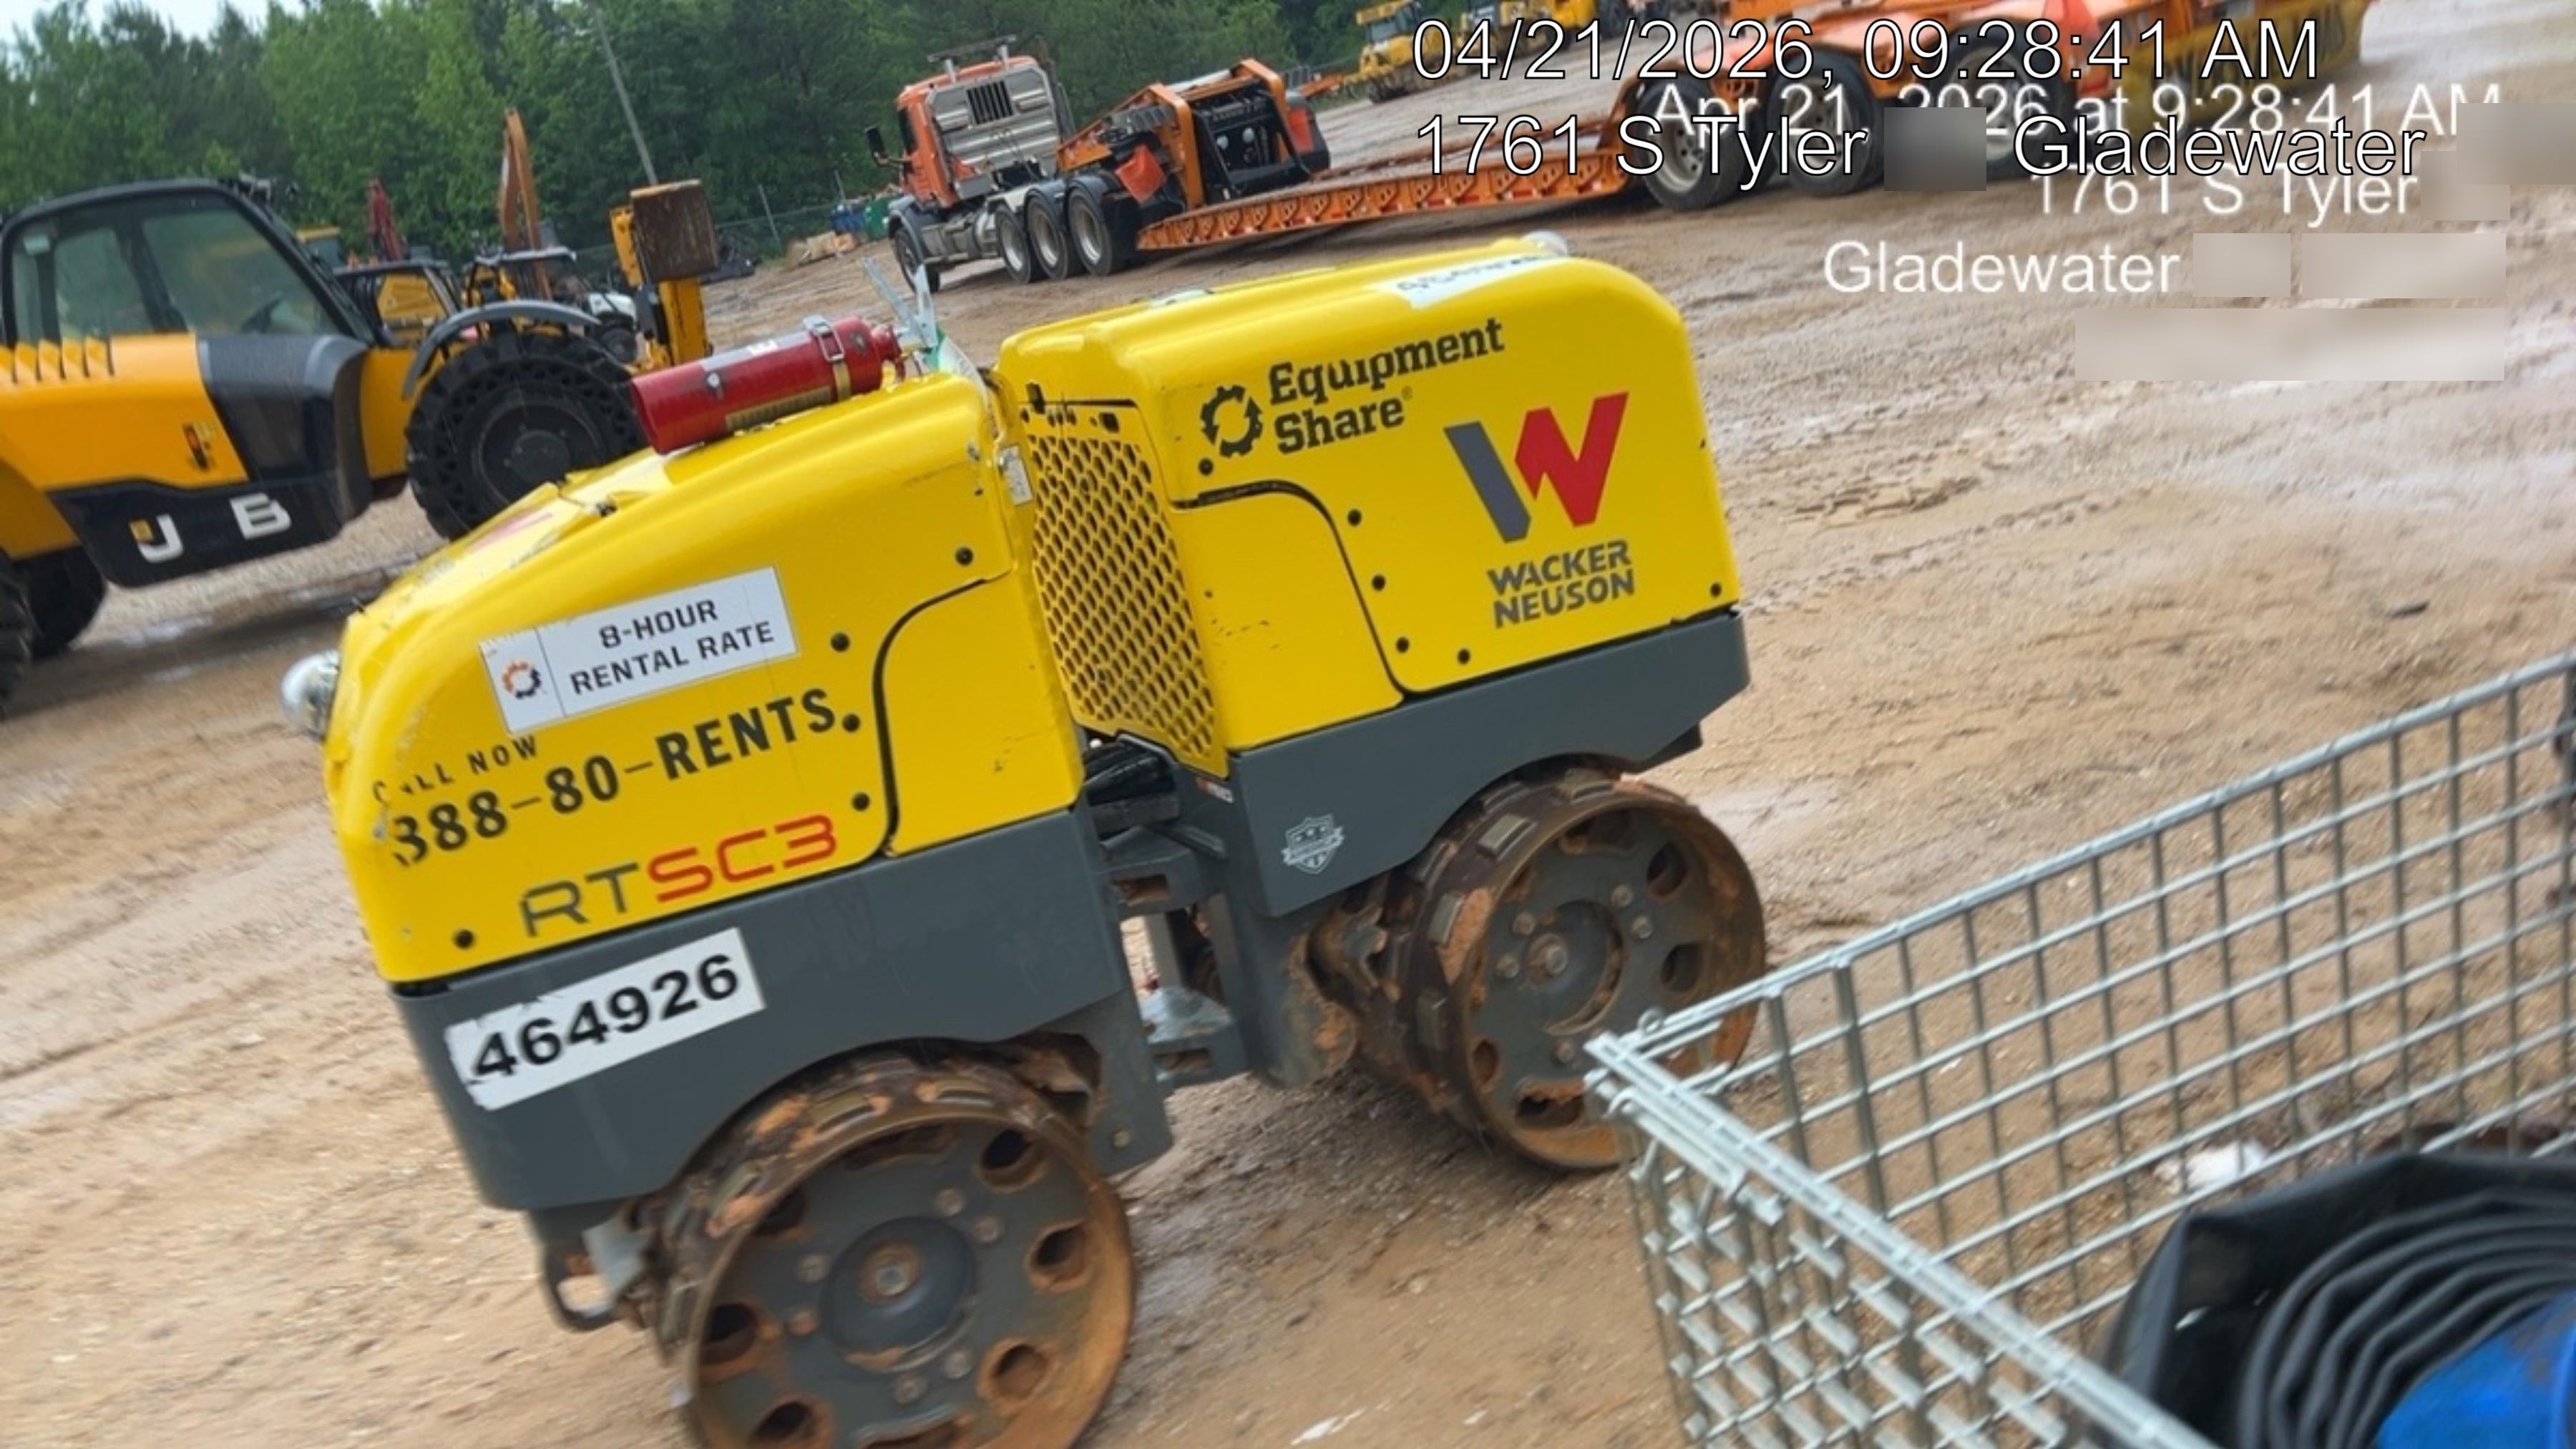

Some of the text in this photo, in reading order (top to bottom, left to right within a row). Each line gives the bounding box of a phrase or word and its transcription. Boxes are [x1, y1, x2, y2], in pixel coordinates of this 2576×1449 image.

[1267, 317, 1506, 406] Equipment
[1487, 540, 1633, 596] WACKER
[599, 599, 718, 649] 8-HOUR
[1493, 569, 1635, 629] NEUSON
[570, 621, 775, 695] RENTAL RATE
[467, 735, 537, 774] NOW
[475, 955, 738, 1078] 464926
